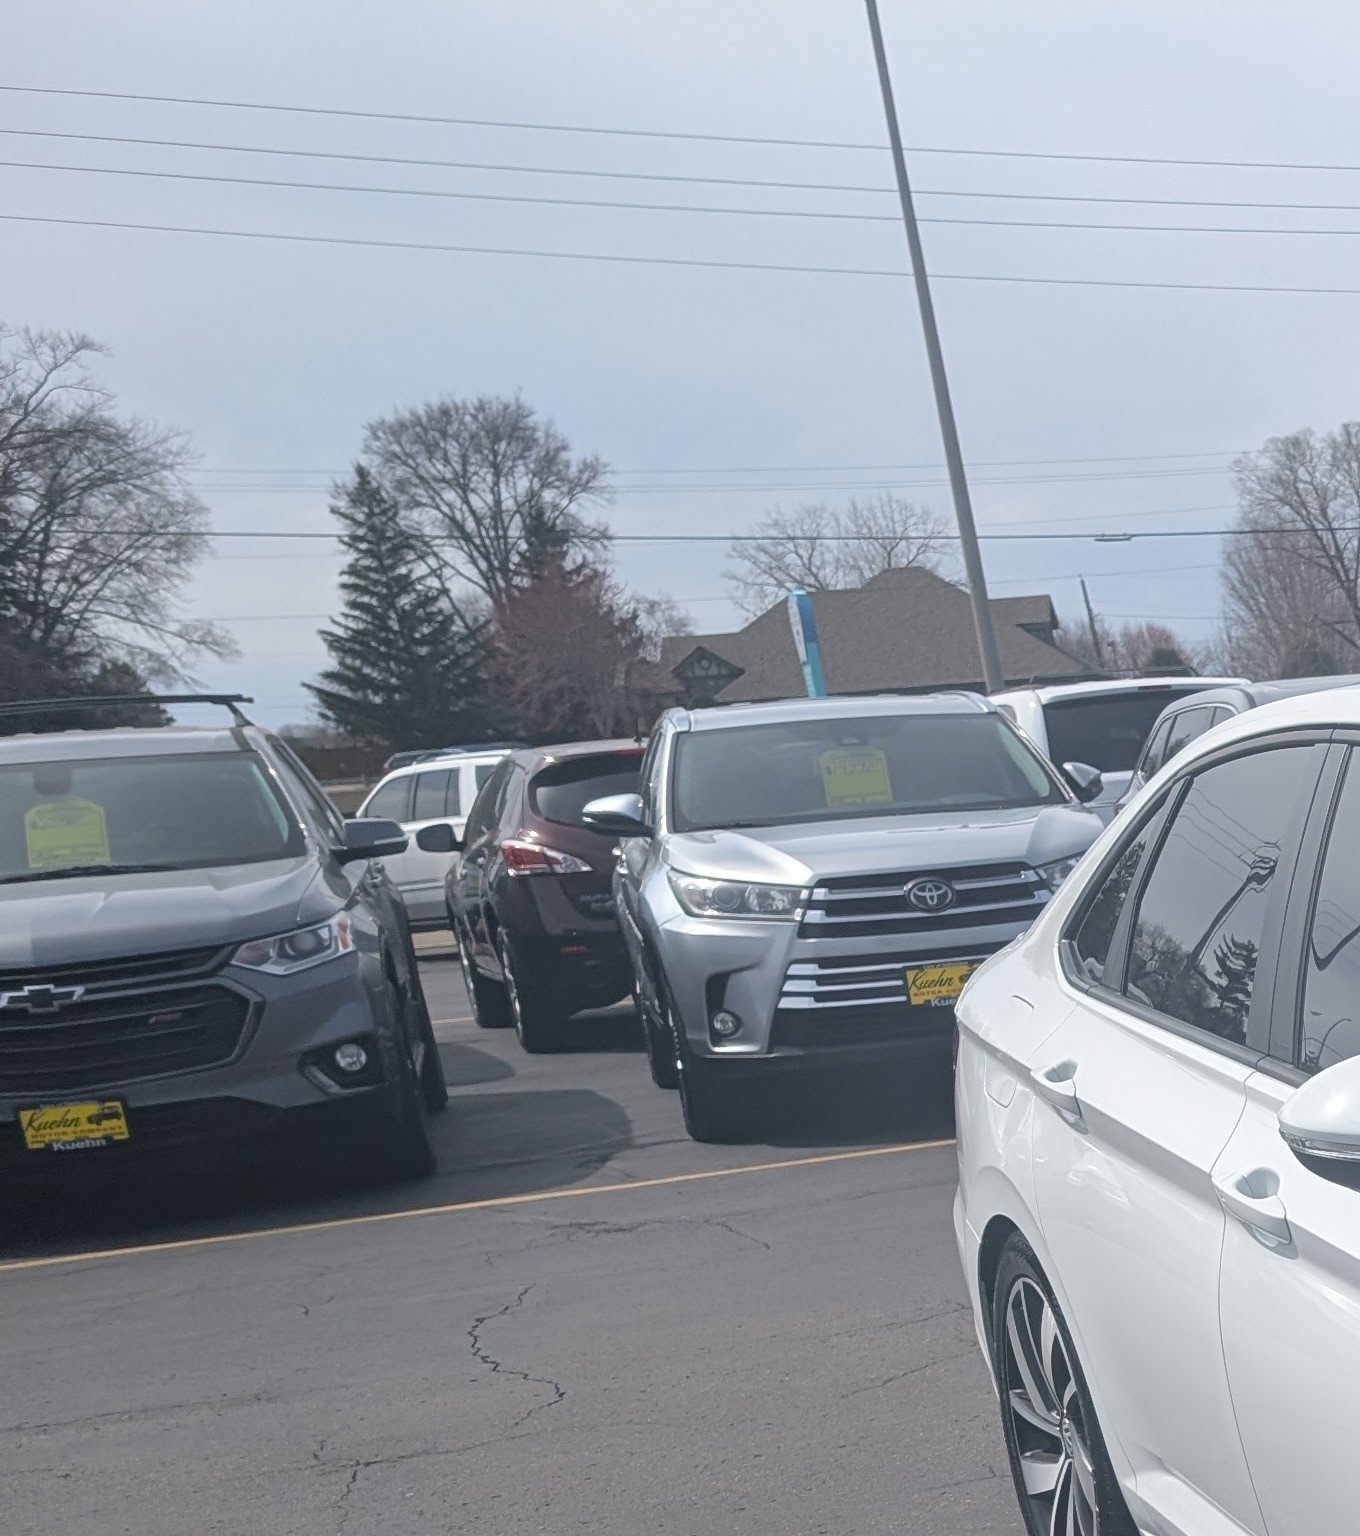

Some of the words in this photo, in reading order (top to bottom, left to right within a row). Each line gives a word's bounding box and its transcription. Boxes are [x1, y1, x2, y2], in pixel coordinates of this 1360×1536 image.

[910, 968, 954, 990] Kuehn
[25, 1108, 80, 1132] Kuehn
[52, 1139, 107, 1151] Kuehn
